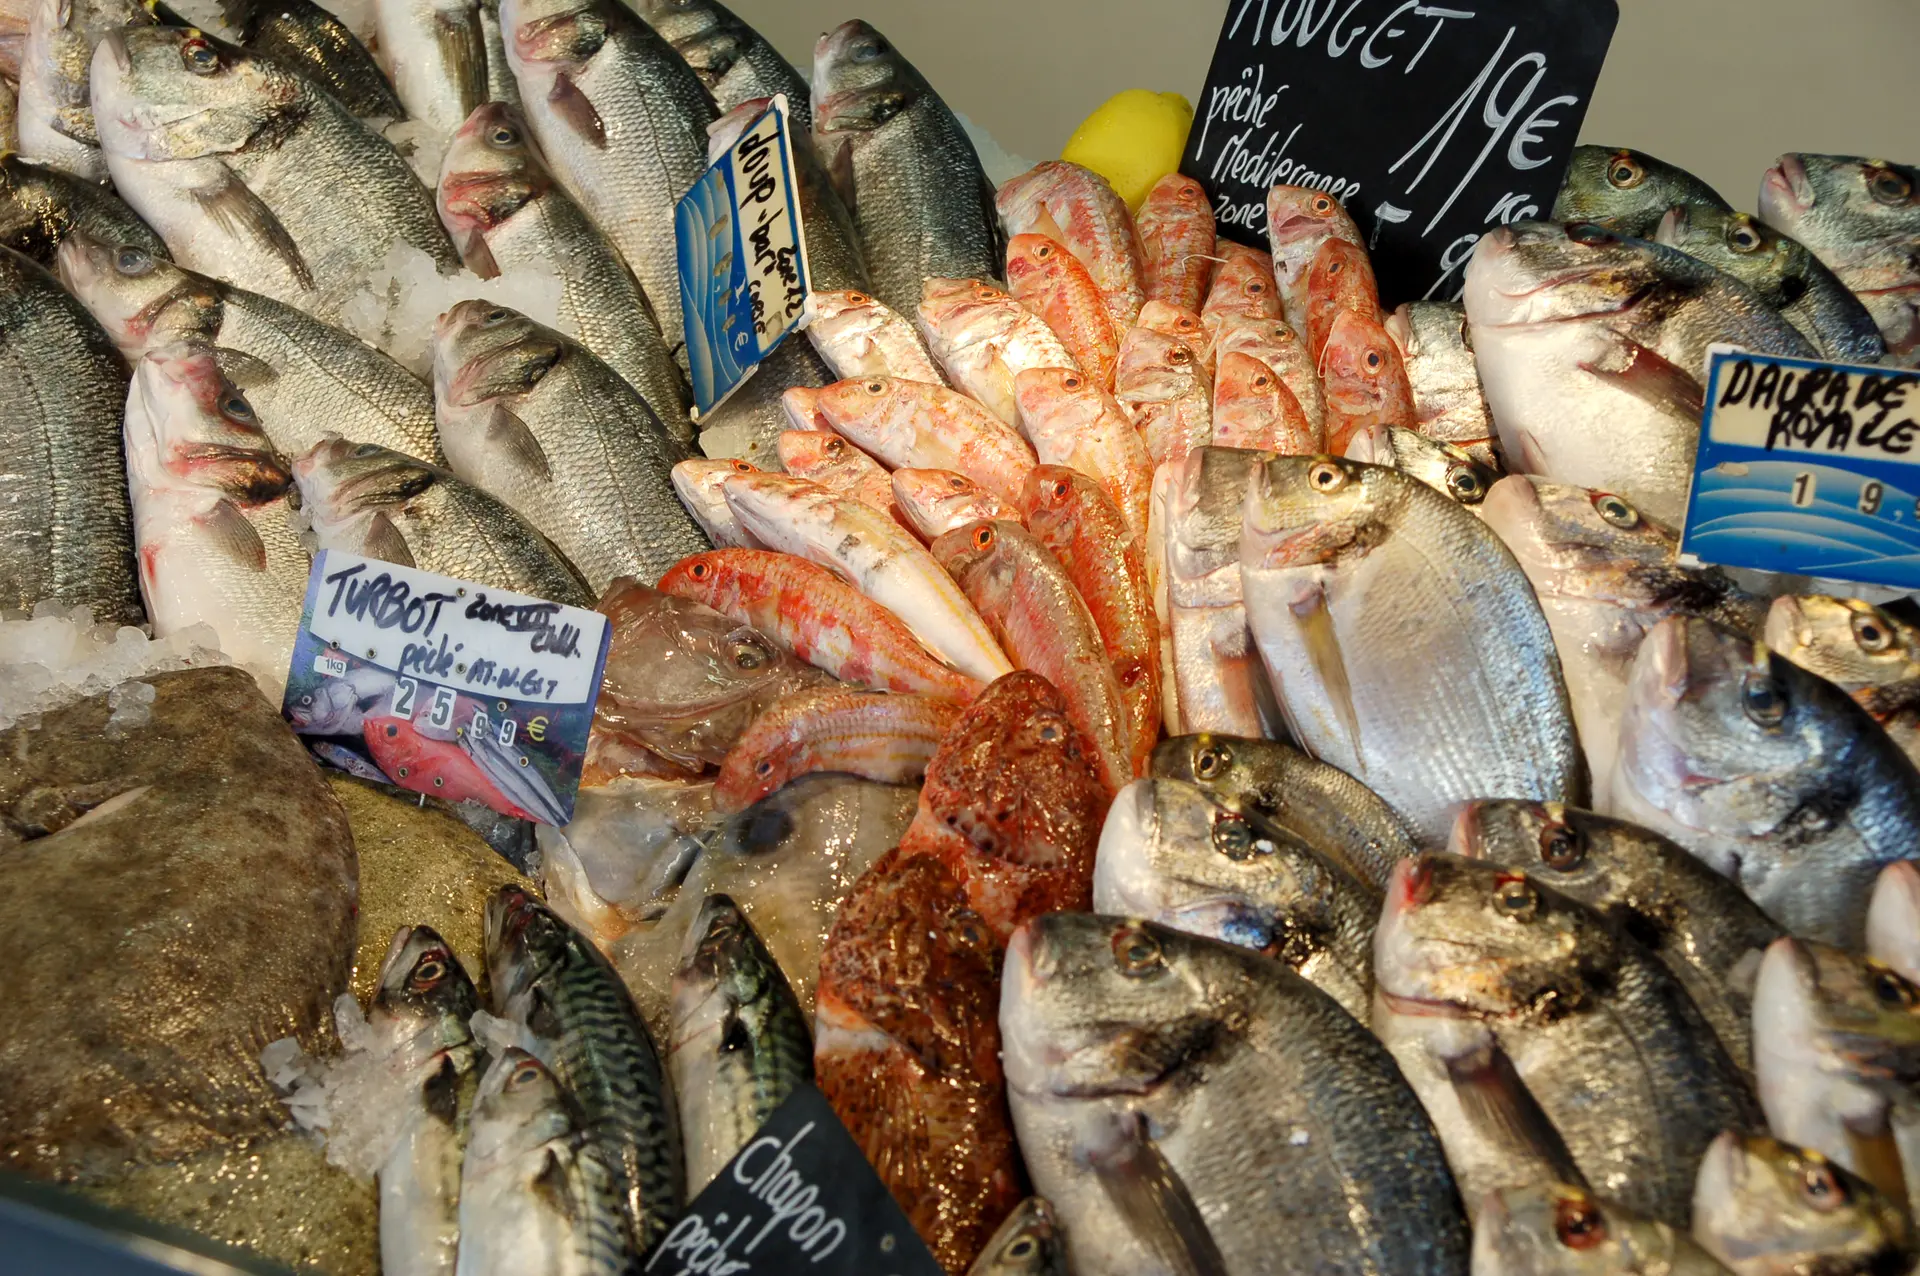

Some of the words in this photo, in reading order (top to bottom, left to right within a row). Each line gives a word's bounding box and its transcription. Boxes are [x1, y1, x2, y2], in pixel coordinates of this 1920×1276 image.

[1719, 359, 1919, 411] DAURADE
[1765, 406, 1920, 453] ROYALE
[326, 563, 457, 638] TURBOT
[325, 658, 344, 673] 1kg
[733, 1121, 846, 1262] Chapon
